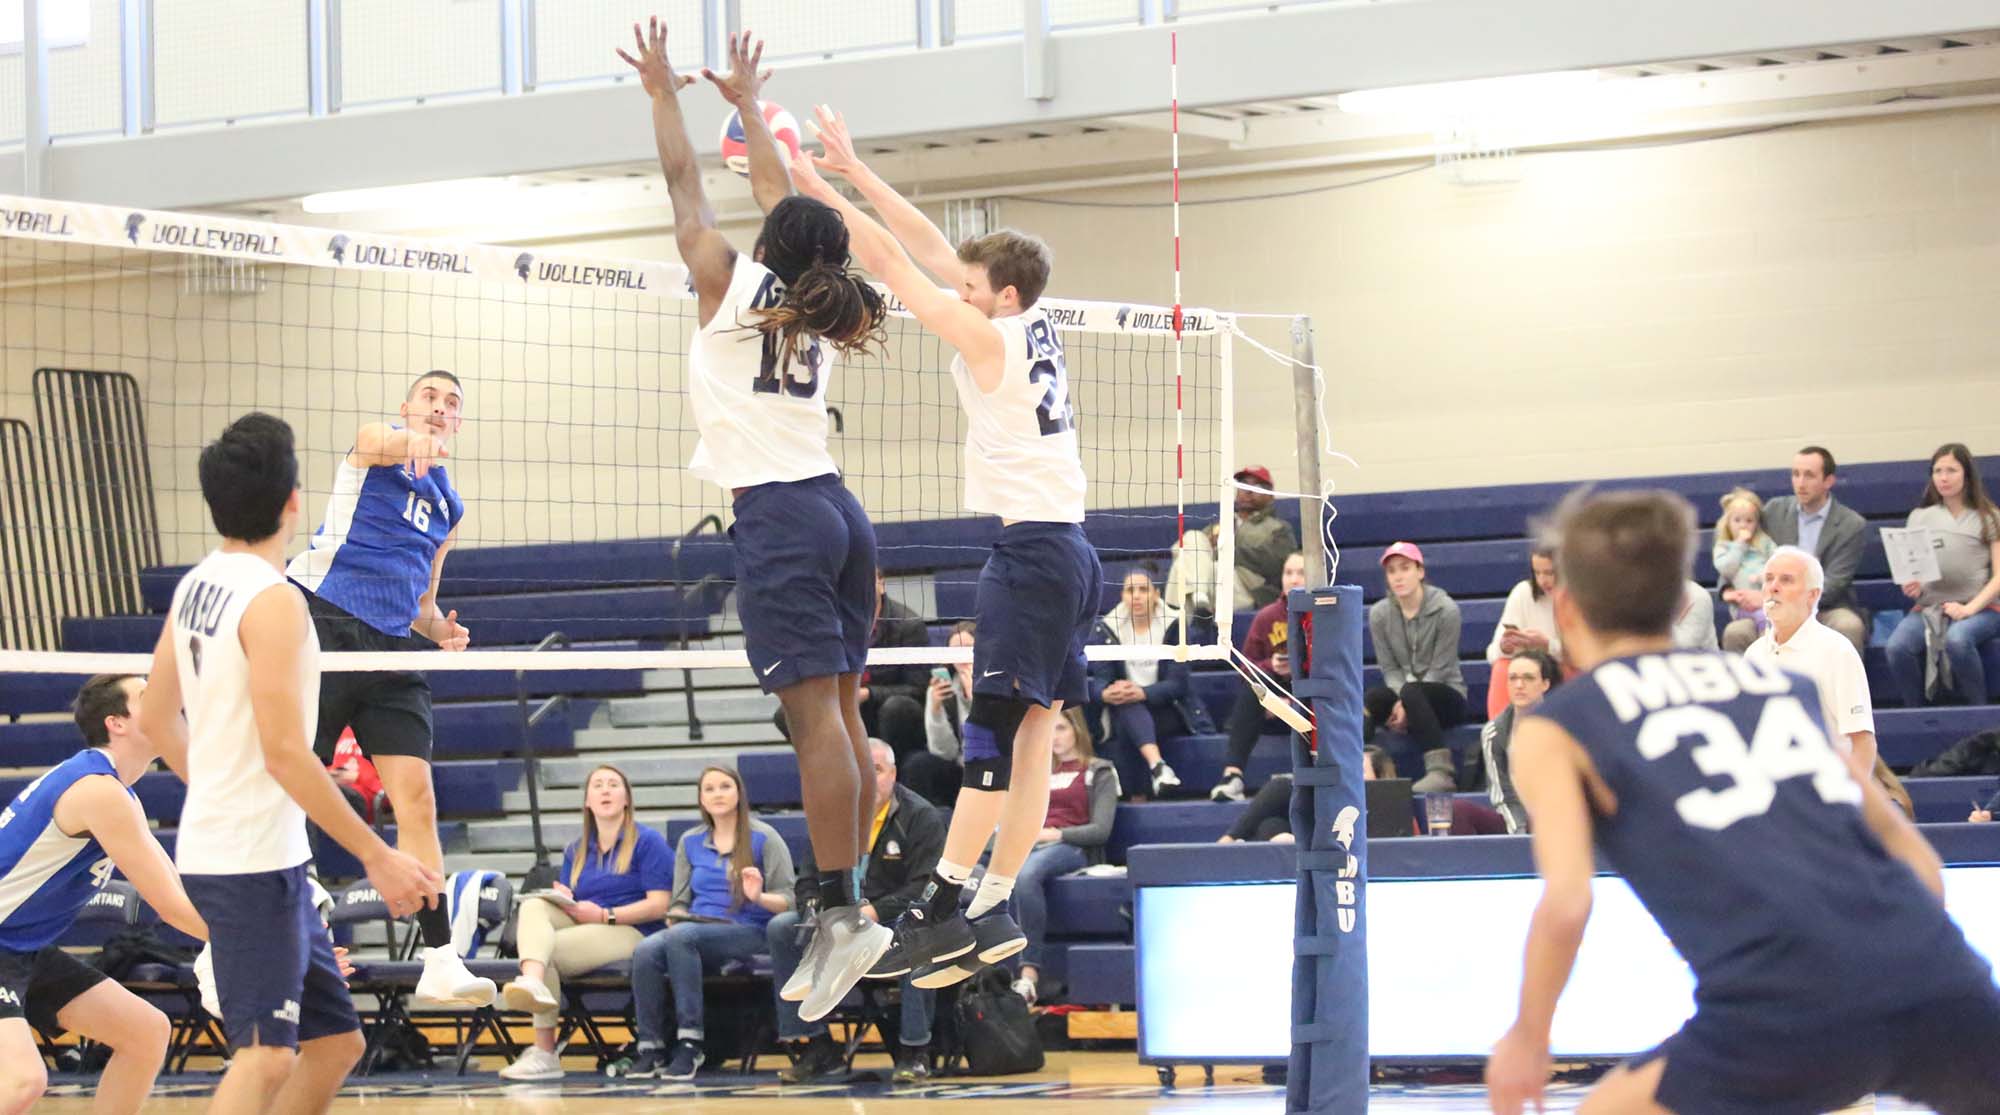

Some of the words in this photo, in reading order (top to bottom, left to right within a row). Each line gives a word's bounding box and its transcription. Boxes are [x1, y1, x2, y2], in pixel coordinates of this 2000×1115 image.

[152, 223, 283, 256] VOLLEYBALL
[355, 244, 473, 274] VOLLEYBALL
[538, 262, 647, 291] VOLLEYBALL
[402, 491, 432, 533] 16
[1593, 652, 1792, 723] MBU
[1636, 696, 1863, 831] 34
